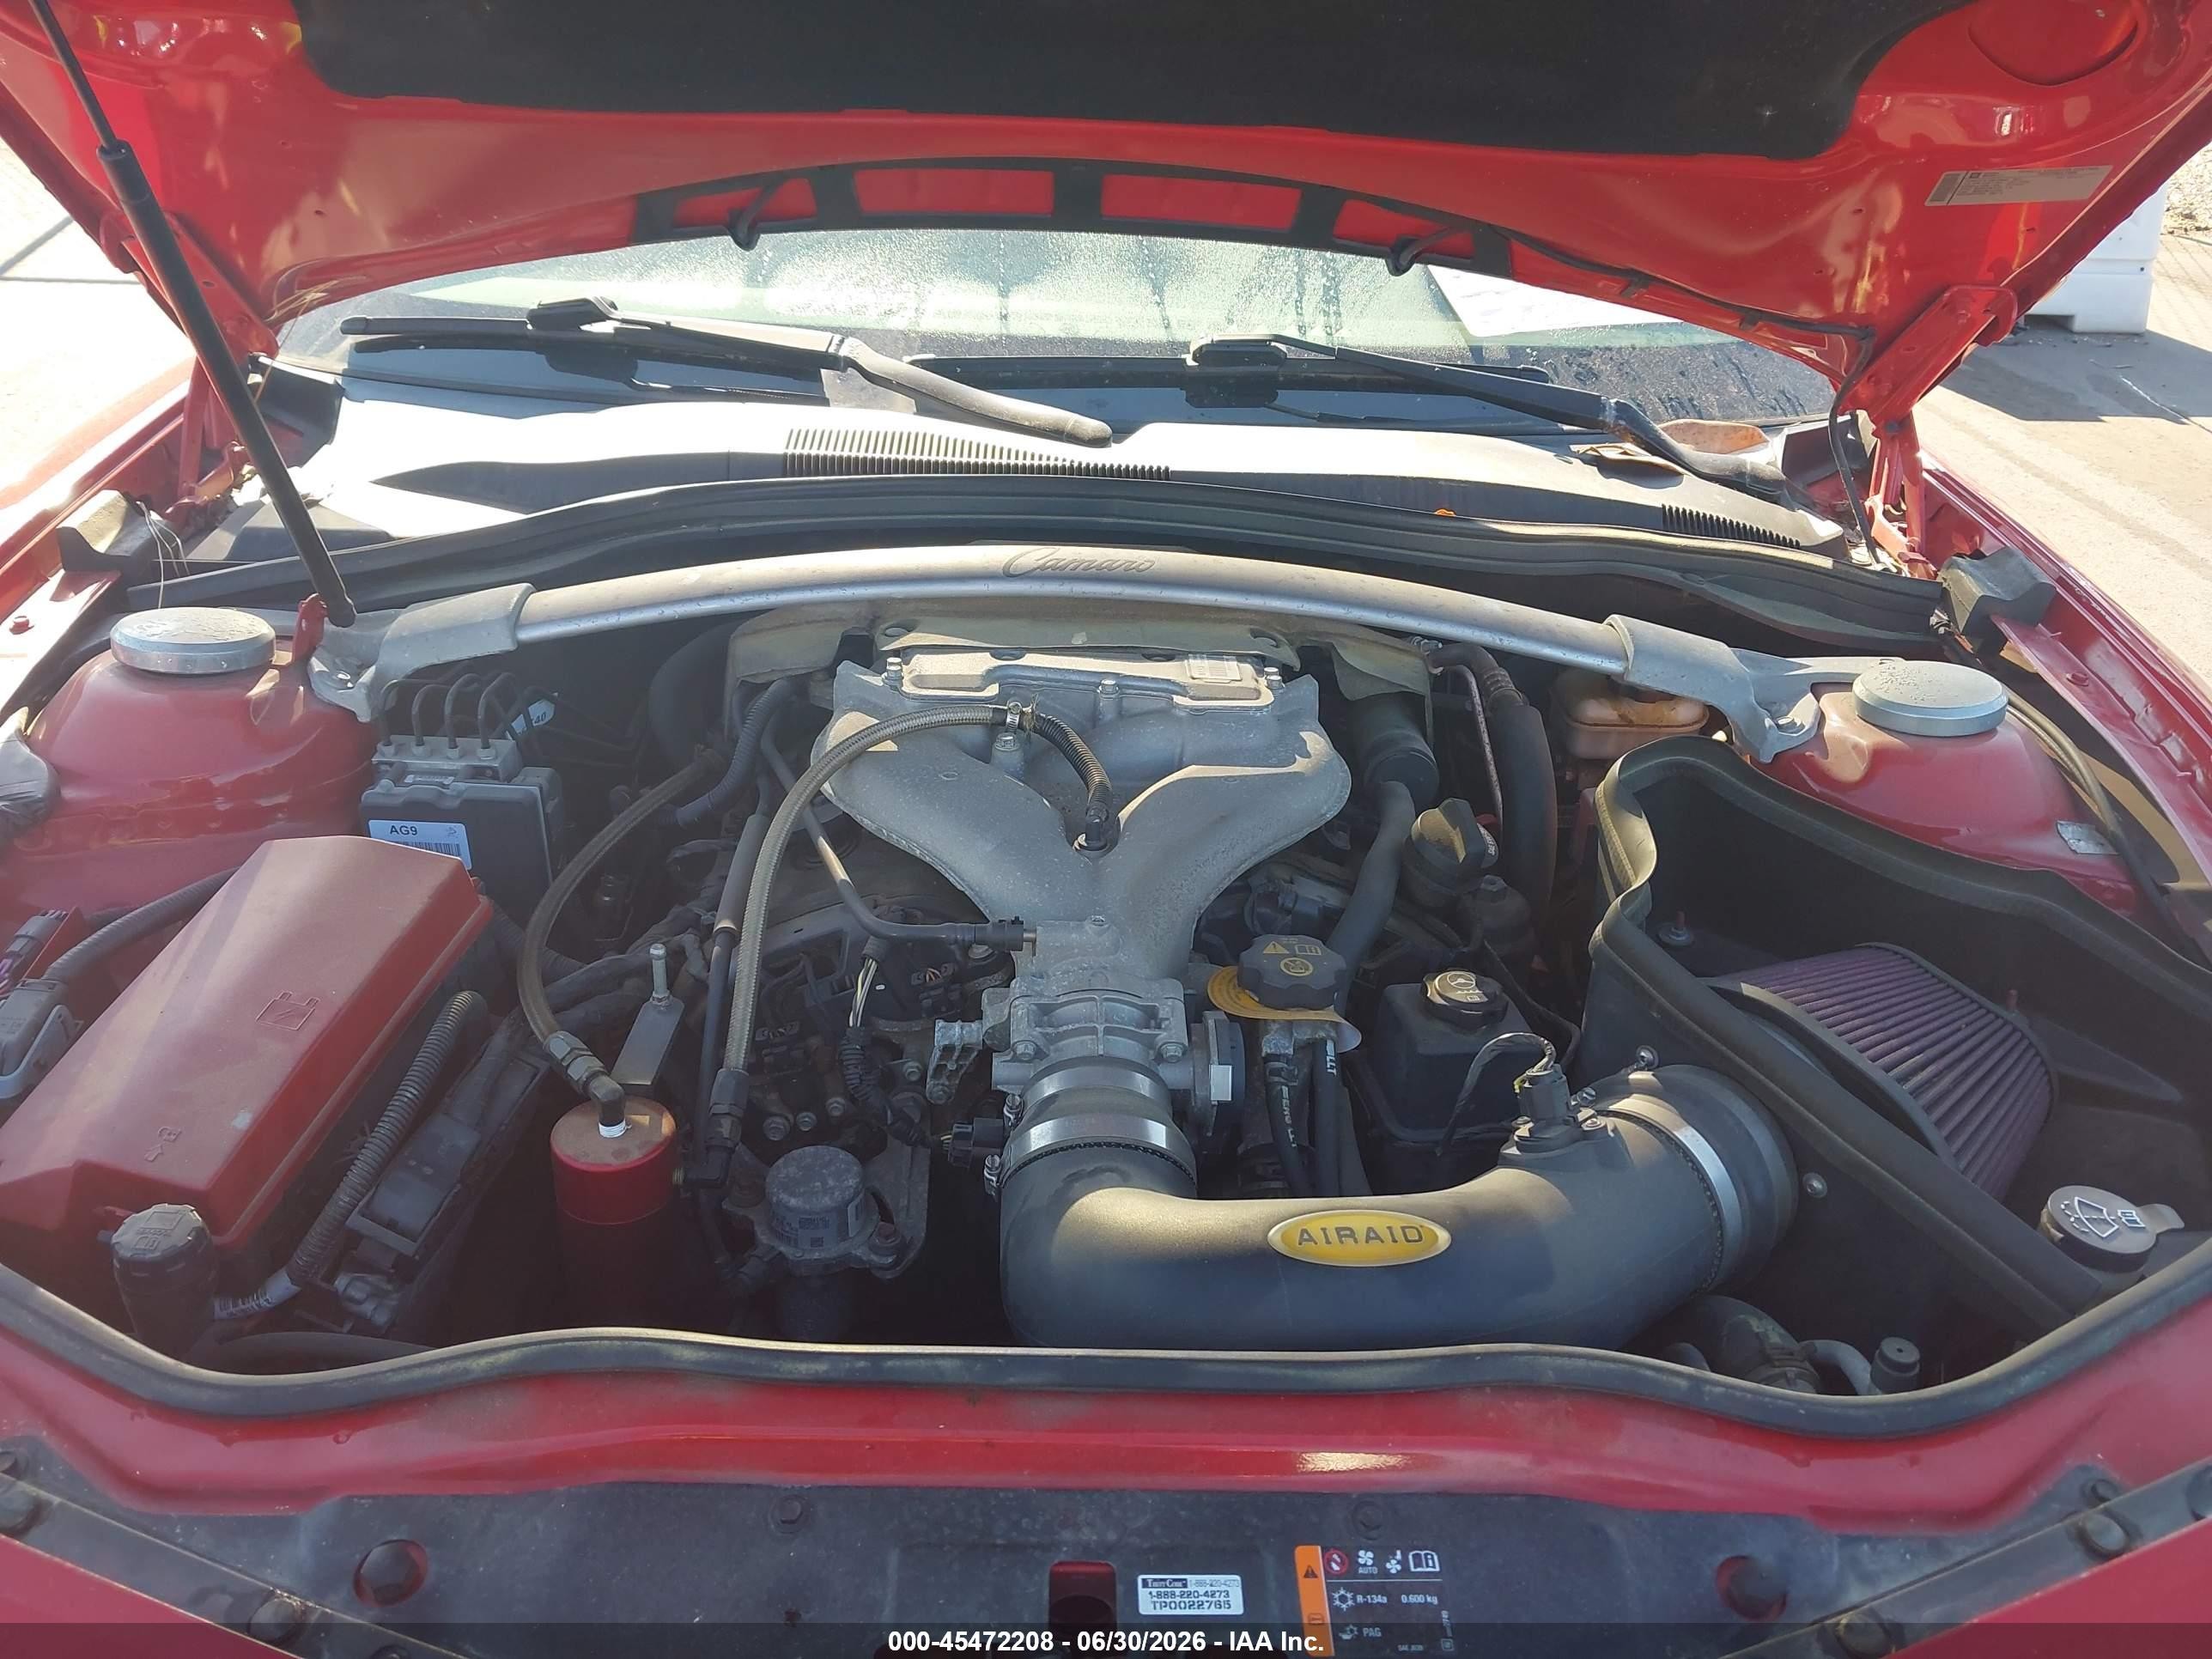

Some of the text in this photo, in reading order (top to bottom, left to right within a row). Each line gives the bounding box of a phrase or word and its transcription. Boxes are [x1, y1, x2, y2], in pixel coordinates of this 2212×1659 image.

[1002, 546, 1156, 578] Camaro
[389, 824, 418, 836] AG9
[1297, 1224, 1424, 1246] AIRAID
[1358, 1566, 1378, 1575] AUTO
[1148, 1589, 1230, 1599] 1-888-220-4273
[1356, 1594, 1388, 1604] R-134a
[1426, 1594, 1438, 1605] kg
[1363, 1627, 1382, 1638] PAG
